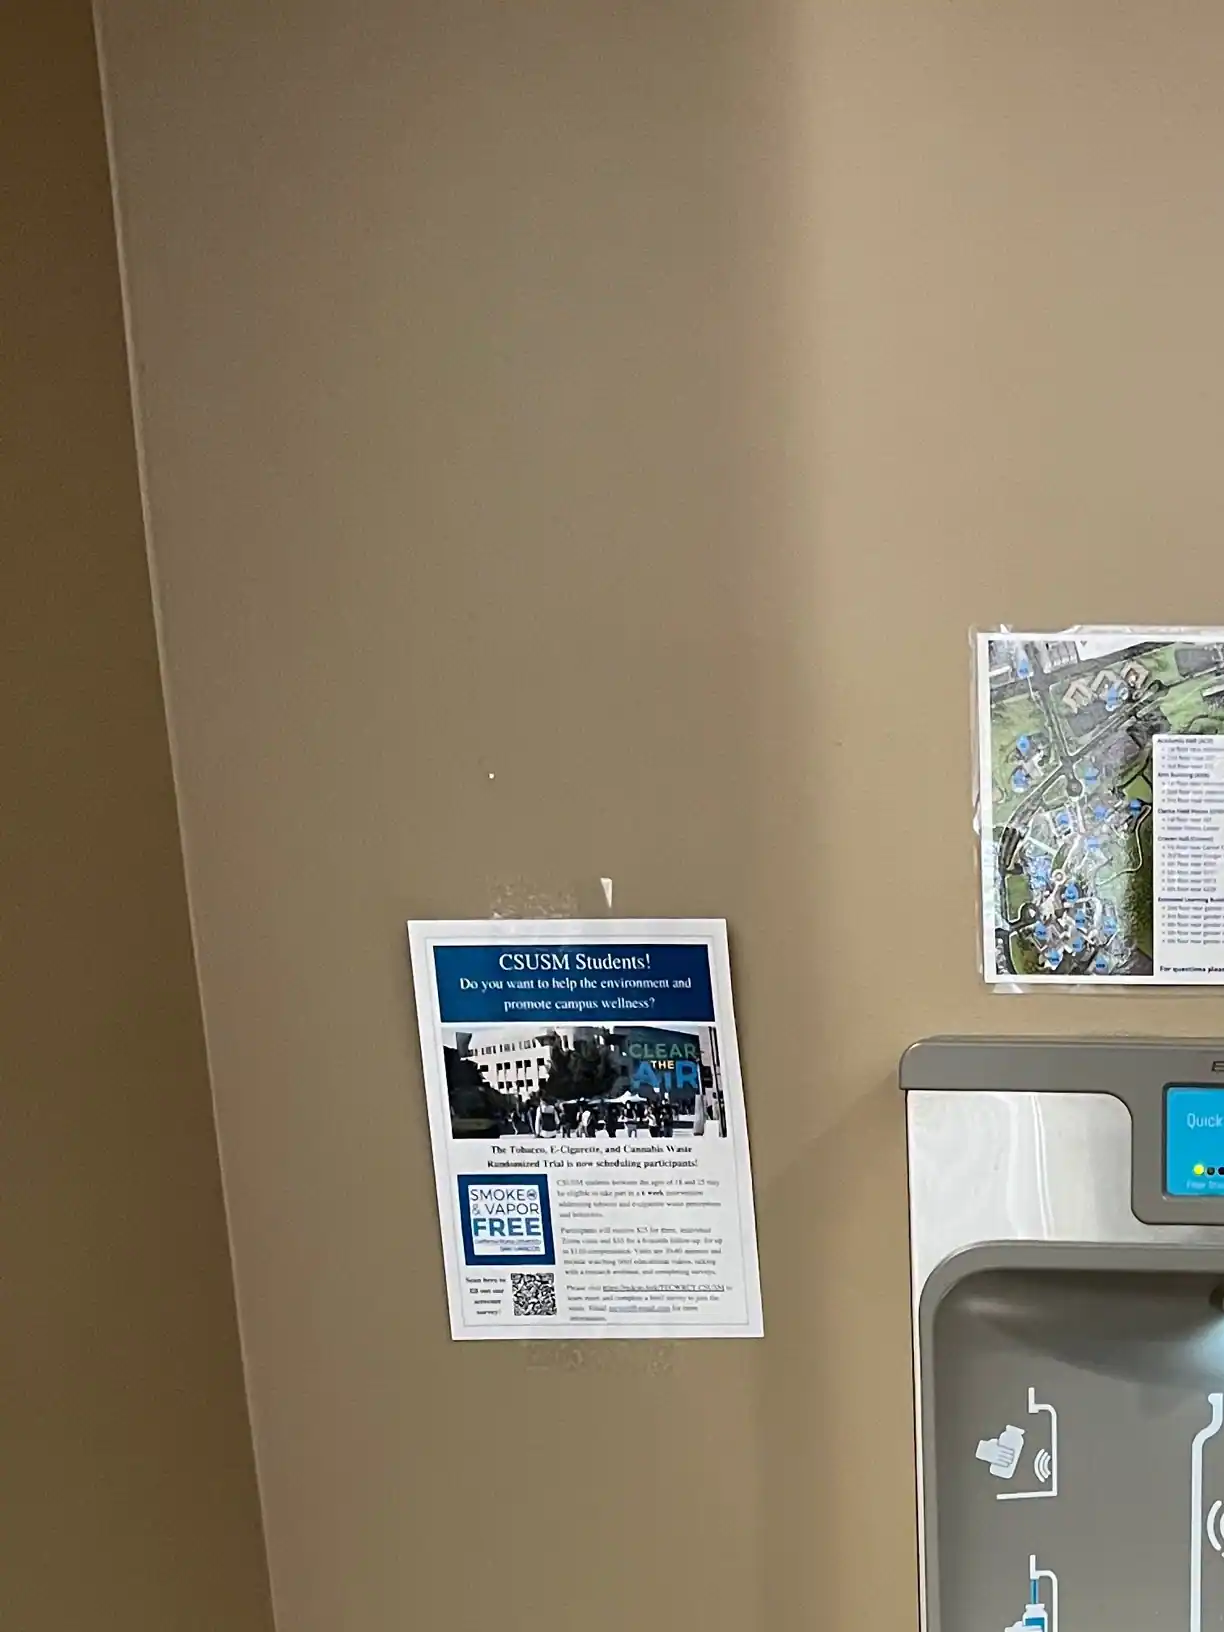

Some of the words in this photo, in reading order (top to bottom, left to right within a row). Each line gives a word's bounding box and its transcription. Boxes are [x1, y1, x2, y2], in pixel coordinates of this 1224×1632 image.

[499, 953, 570, 971] CSUSM
[576, 953, 651, 971] Students!
[460, 978, 478, 989] Do
[481, 979, 503, 993] you
[506, 979, 534, 989] want
[537, 979, 550, 989] to
[552, 978, 577, 993] help
[580, 977, 597, 989] the
[600, 978, 669, 989] environment
[672, 977, 692, 988] and
[504, 999, 551, 1012] promote
[554, 1000, 598, 1012] campus
[601, 997, 655, 1009] wellness?
[629, 1044, 697, 1058] CLEAR
[650, 1061, 674, 1069] THE
[1187, 1113, 1223, 1130] Quick
[543, 1160, 564, 1168] Trial
[566, 1160, 573, 1168] is
[596, 1160, 641, 1169] scheduling
[644, 1160, 698, 1169] participants!
[471, 1189, 525, 1201] SMOKE
[472, 1204, 480, 1215] &
[484, 1203, 539, 1215] VAPOR
[473, 1218, 541, 1237] FREE
